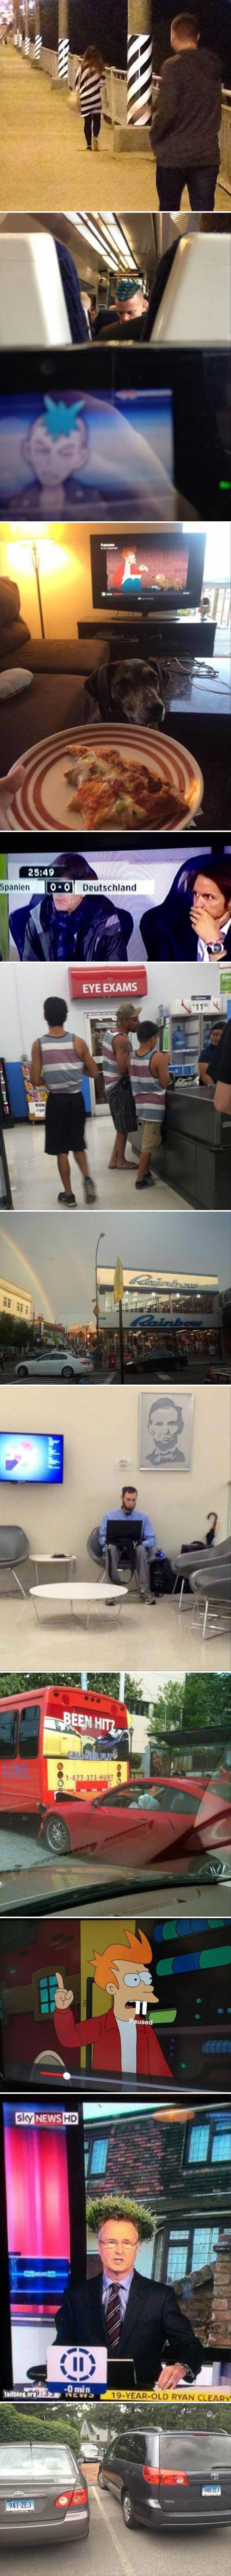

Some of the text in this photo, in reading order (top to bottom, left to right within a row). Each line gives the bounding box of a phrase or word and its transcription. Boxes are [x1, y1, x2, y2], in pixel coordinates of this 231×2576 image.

[28, 868, 54, 876] 25:49
[0, 883, 30, 891] Spanien
[83, 883, 137, 892] Deutschland
[82, 982, 138, 993] EYE EXAMS
[129, 1274, 199, 1288] Rainbow
[130, 1314, 203, 1327] Rainbow
[63, 1712, 115, 1730] BEEN HIT?
[67, 1751, 85, 1759] CALL
[85, 1751, 100, 1760] NEIL
[3, 1763, 29, 1779] LINE
[17, 2113, 33, 2124] sky
[36, 2114, 61, 2123] NEWS
